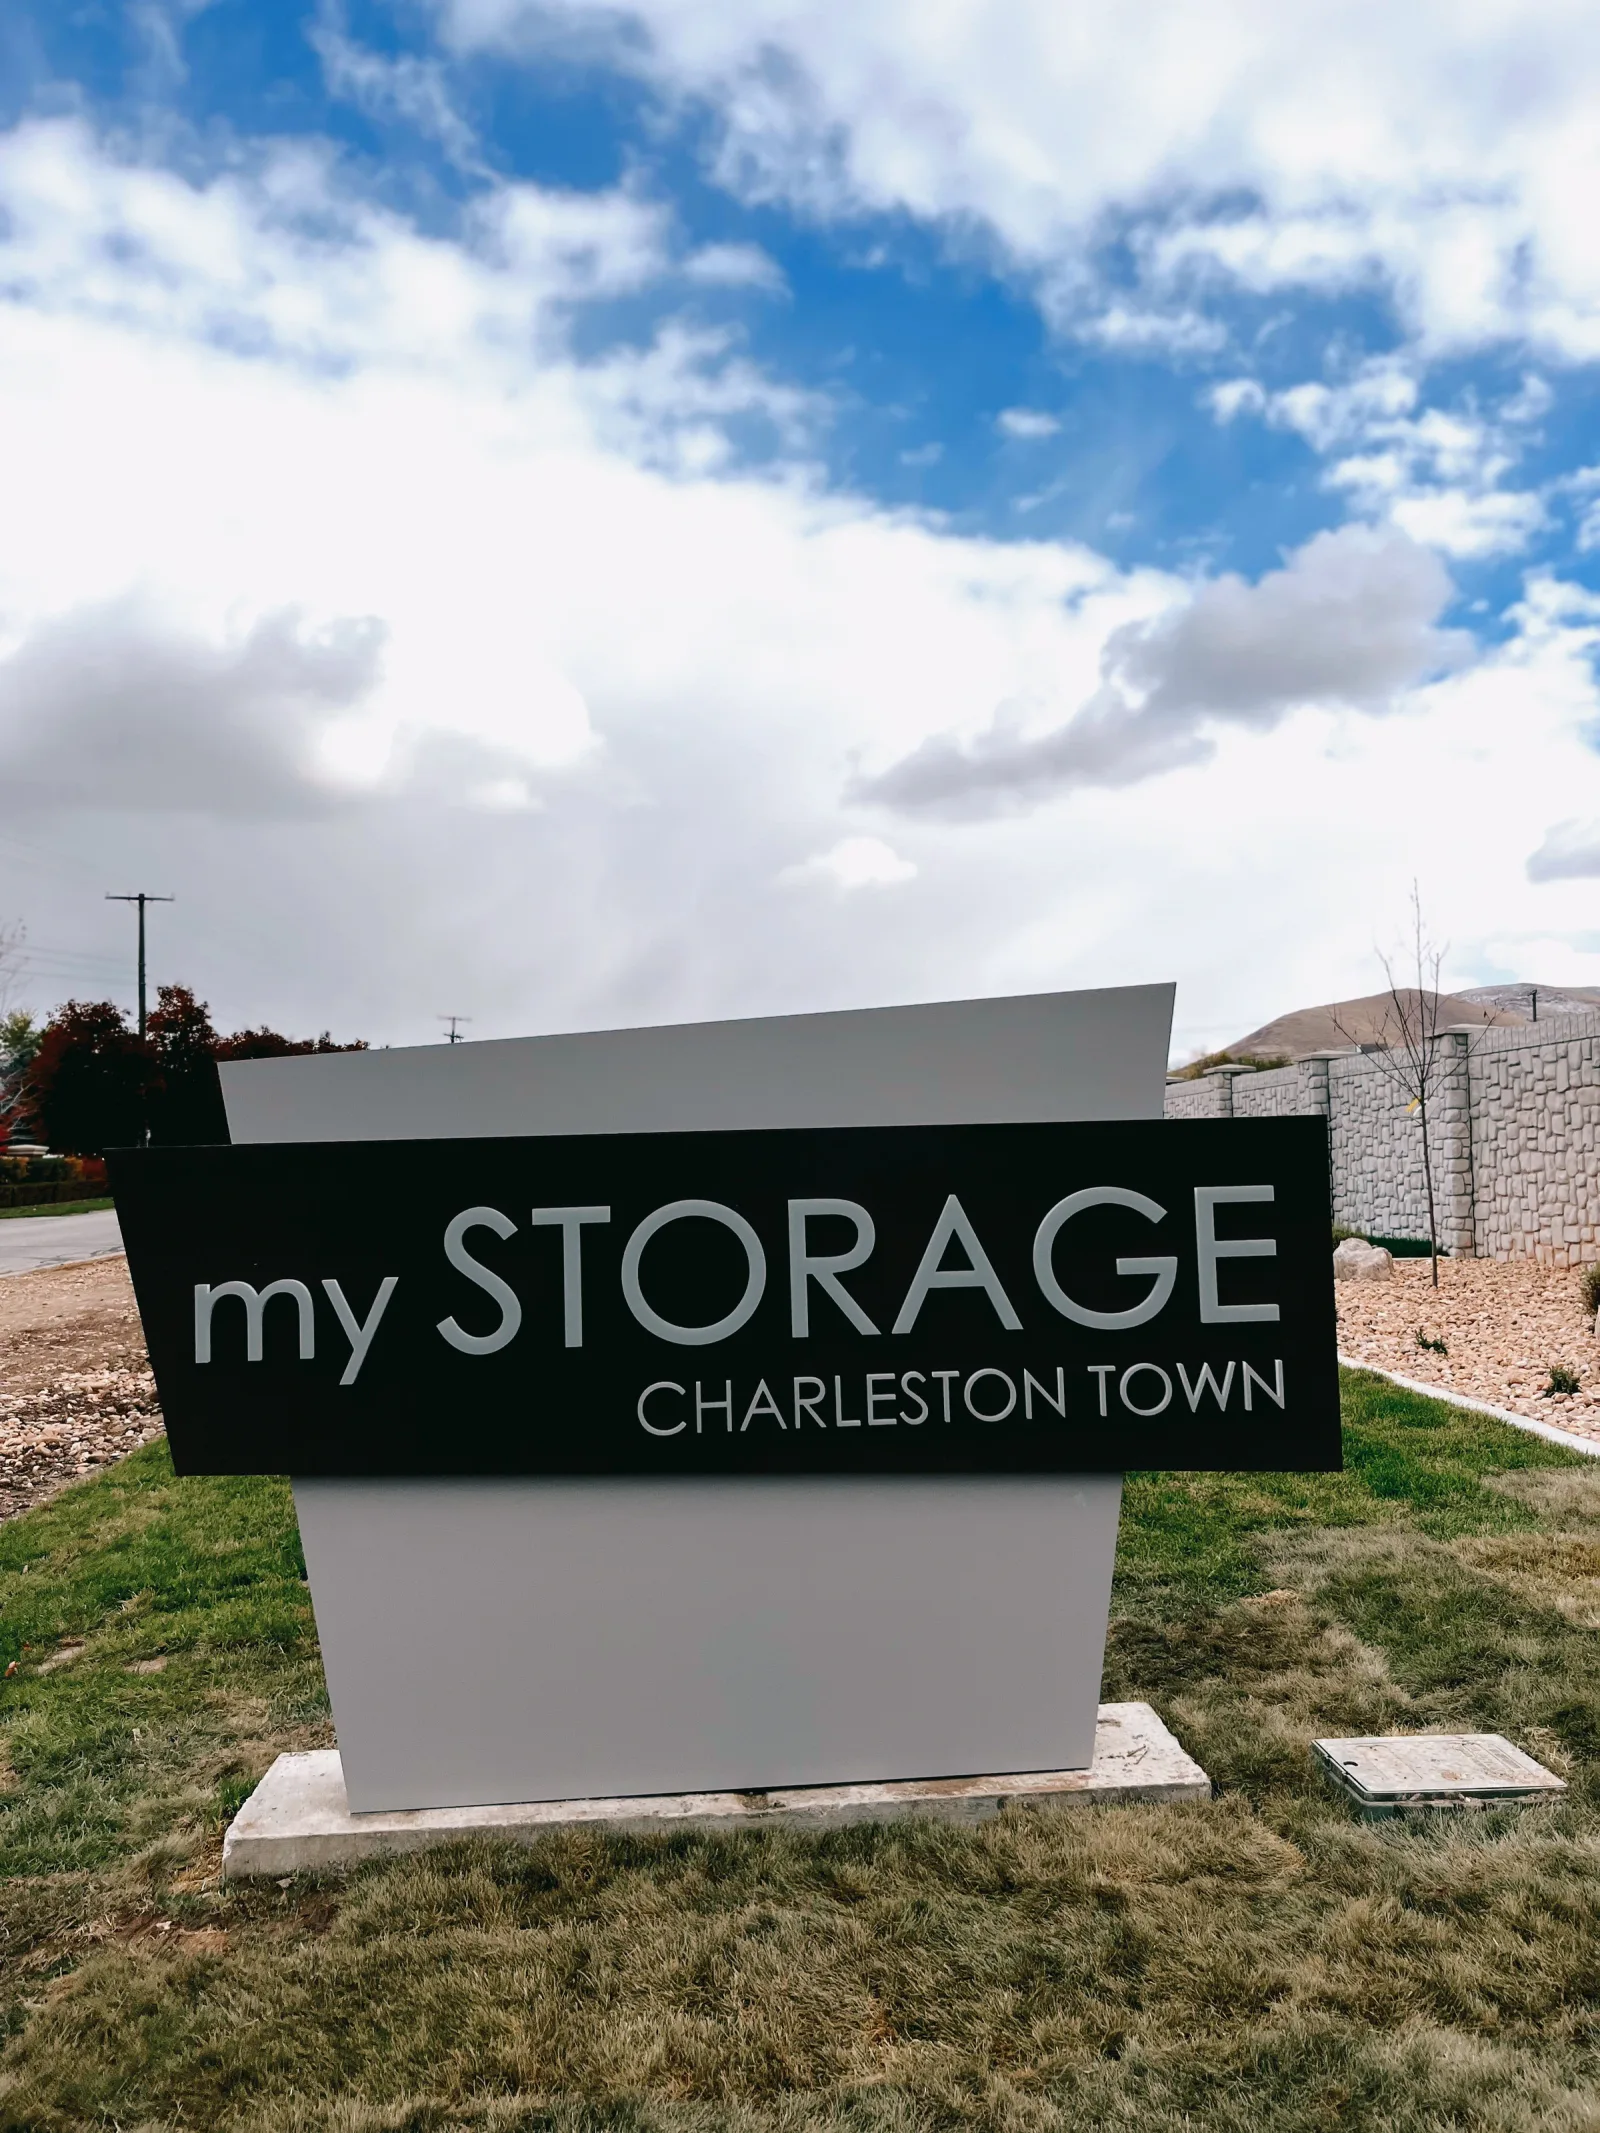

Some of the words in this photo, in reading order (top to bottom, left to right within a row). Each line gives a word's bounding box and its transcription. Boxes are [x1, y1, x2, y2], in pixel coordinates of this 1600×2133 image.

[194, 1276, 400, 1386] my
[436, 1185, 1281, 1356] STORAGE
[637, 1366, 1066, 1436] CHARLESTON
[1087, 1359, 1286, 1417] TOWN
